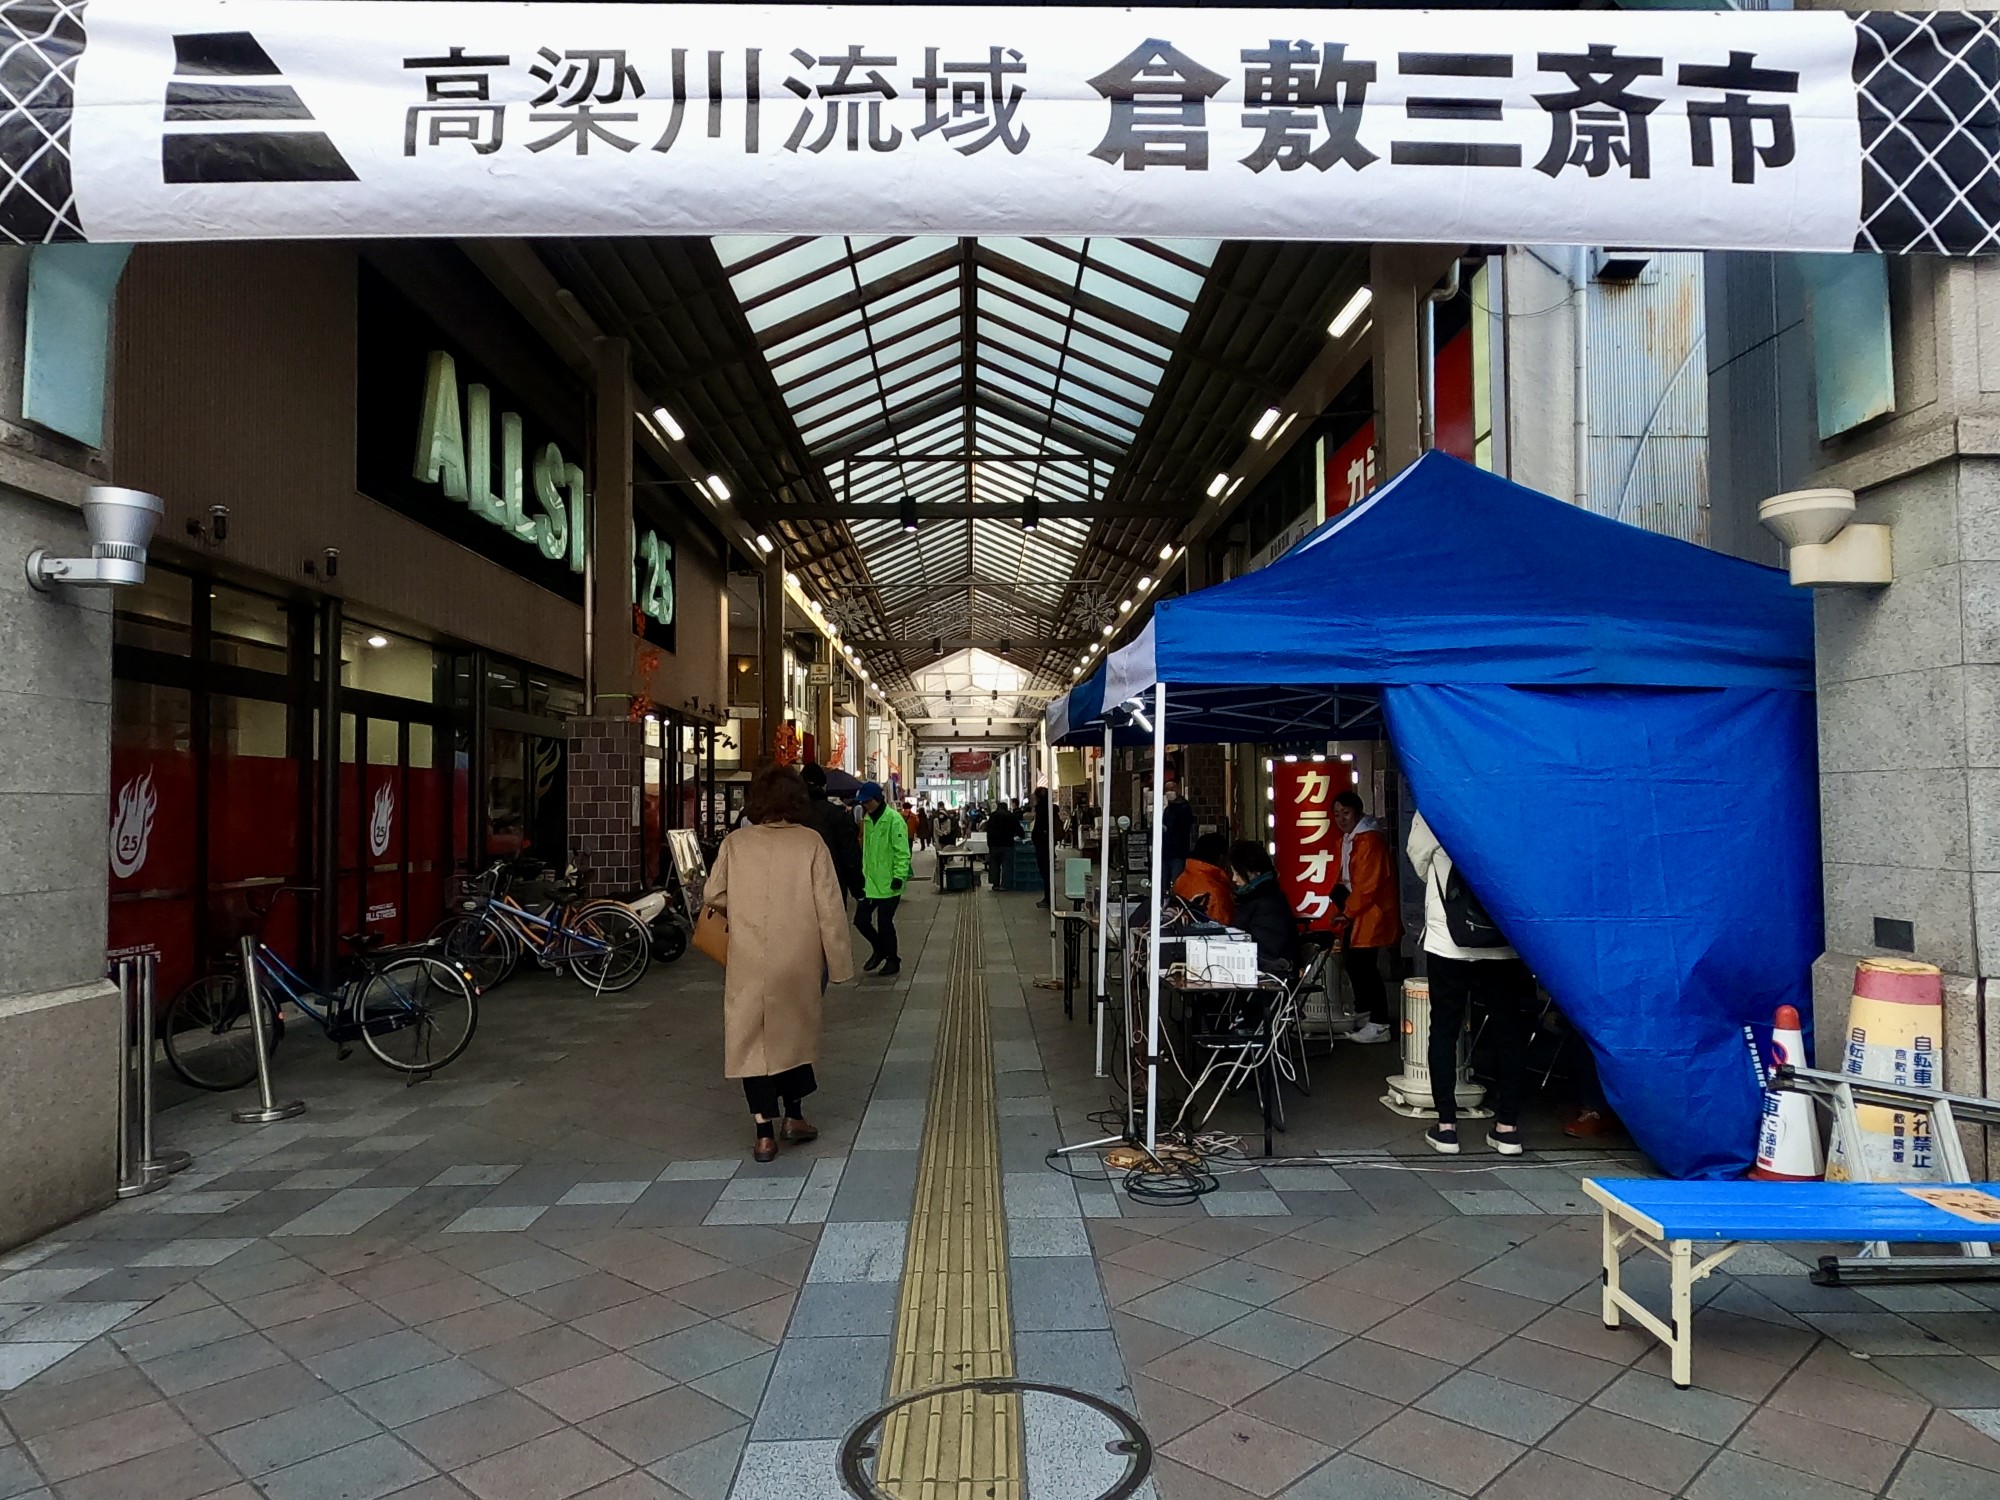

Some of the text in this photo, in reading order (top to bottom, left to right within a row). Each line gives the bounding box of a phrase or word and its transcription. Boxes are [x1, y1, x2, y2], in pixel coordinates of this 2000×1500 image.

[403, 37, 1800, 185] 高梁川流域 倉敷三斎市
[121, 835, 139, 852] 25
[1294, 770, 1335, 919] カラオケ
[1748, 1042, 1768, 1089] PARKING
